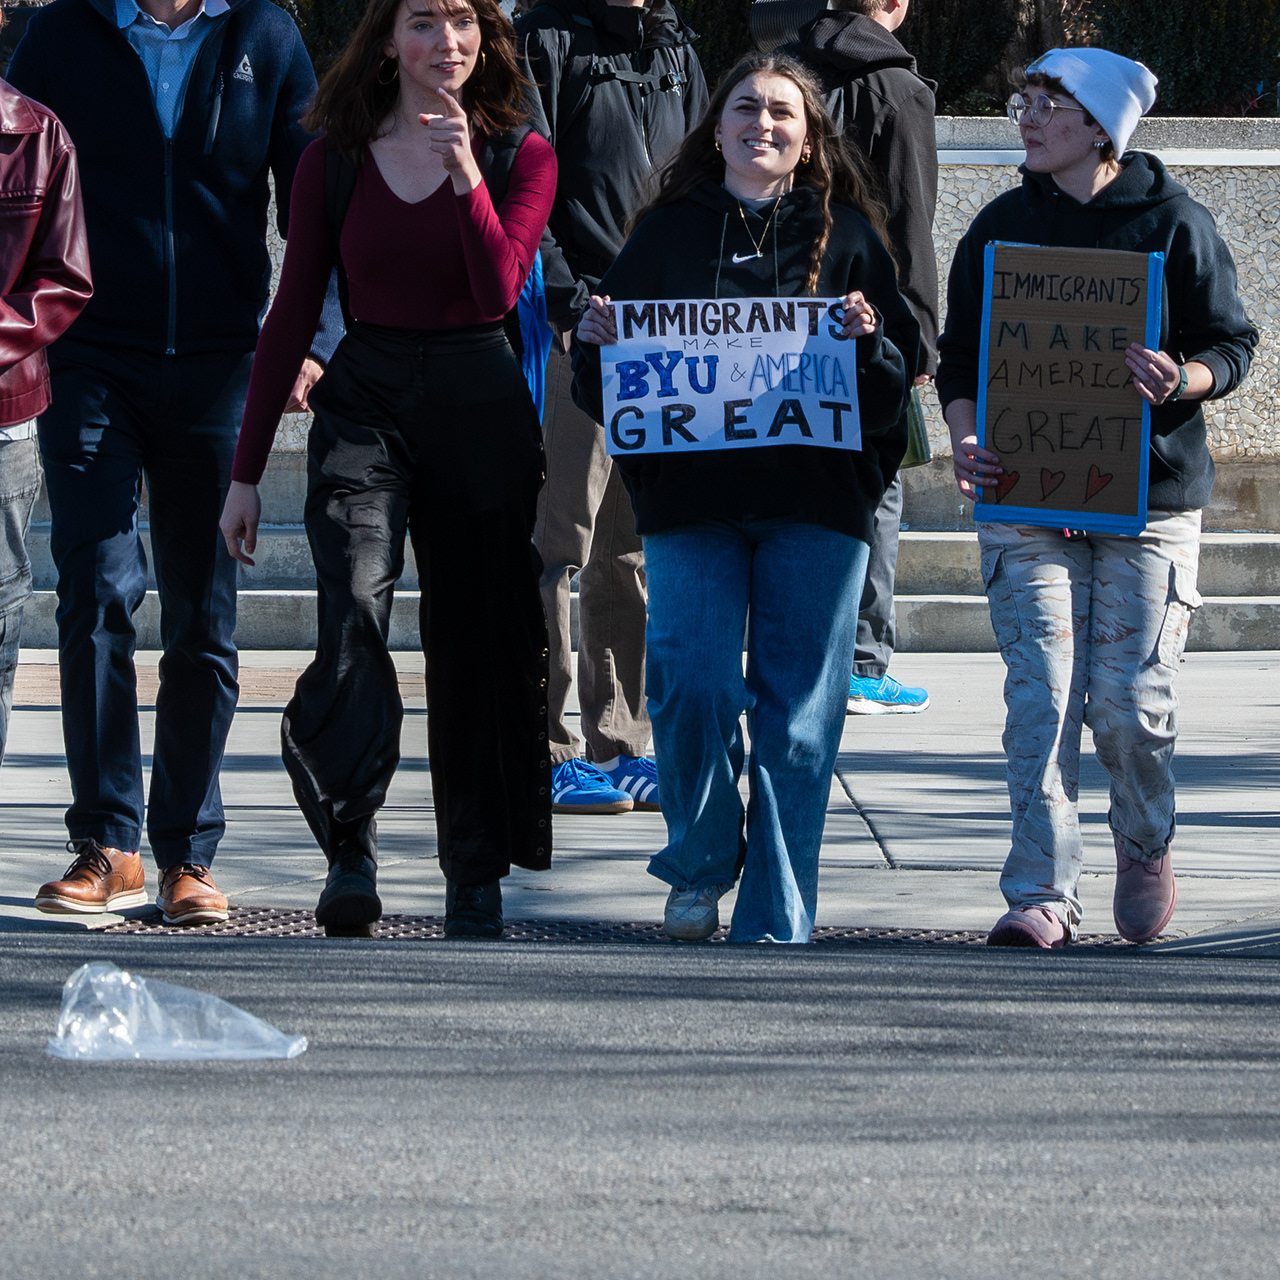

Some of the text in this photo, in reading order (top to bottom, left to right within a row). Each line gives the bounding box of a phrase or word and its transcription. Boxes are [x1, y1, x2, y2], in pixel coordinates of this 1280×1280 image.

[993, 271, 1145, 306] IMMIGRANTS
[683, 336, 763, 351] MAKE
[997, 321, 1128, 352] MAKE
[615, 350, 849, 401] BYU & AMERICA
[610, 398, 852, 451] GREAT
[992, 407, 1142, 454] GREAT
